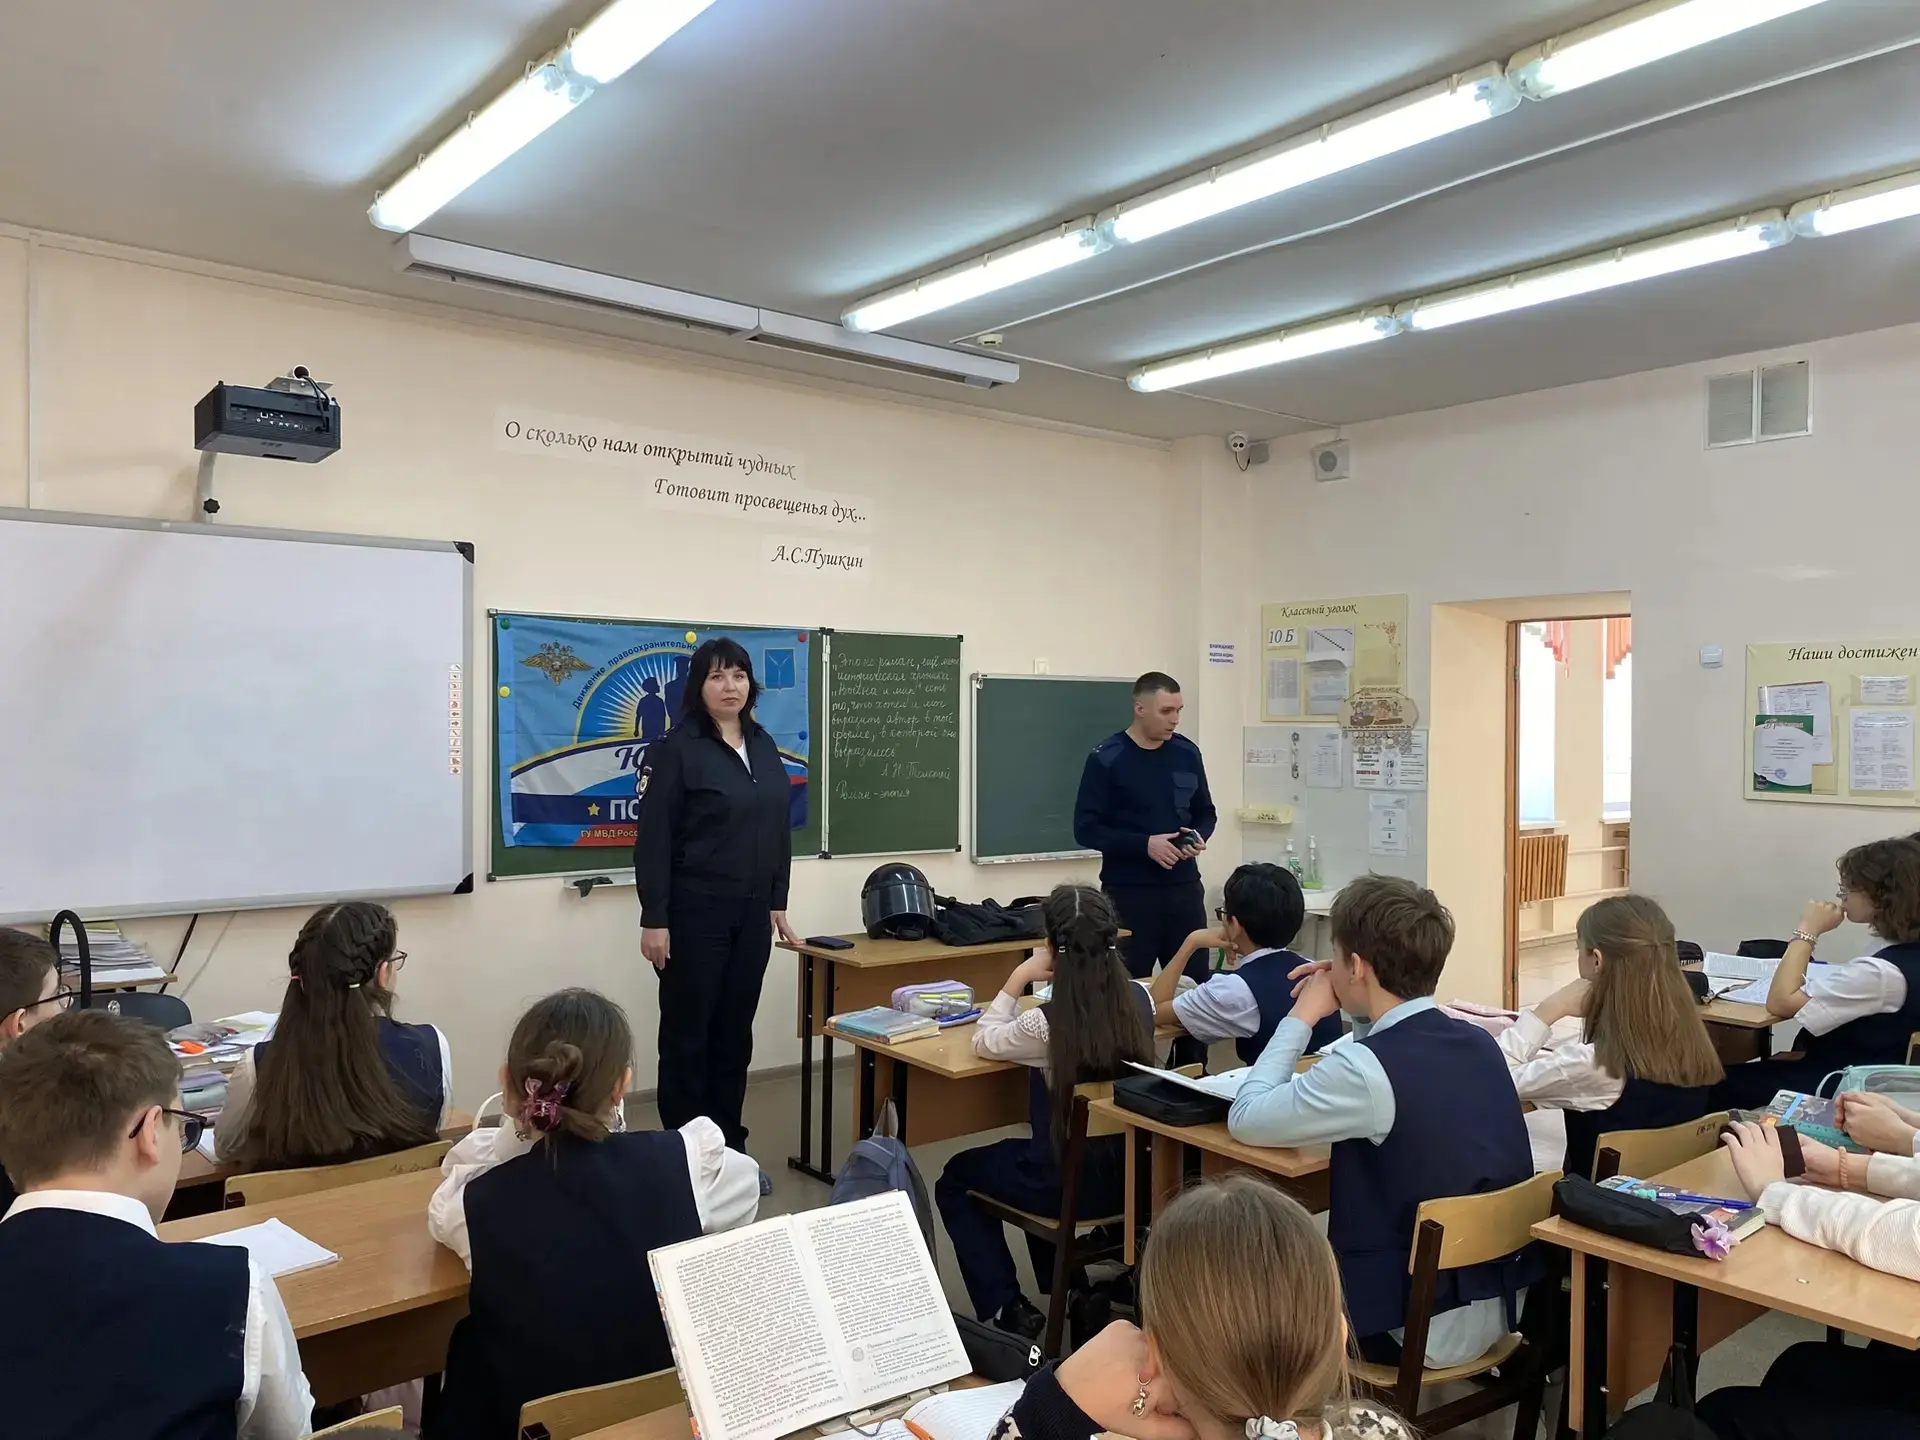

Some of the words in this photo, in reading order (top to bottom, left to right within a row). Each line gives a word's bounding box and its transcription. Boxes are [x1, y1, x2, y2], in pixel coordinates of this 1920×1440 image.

[505, 421, 521, 438] О
[525, 426, 597, 453] сколько
[602, 436, 638, 455] нам
[643, 443, 734, 466] открытий
[738, 454, 797, 480] чудных
[654, 478, 730, 503] Готовит
[735, 491, 828, 516] просвещенья
[831, 500, 866, 523] дух...
[1281, 605, 1325, 618] Классный
[1326, 604, 1358, 617] уголок
[1268, 629, 1283, 643] 10
[1285, 628, 1295, 643] Б
[1788, 647, 1833, 661] Наши
[572, 666, 606, 709] Движение
[594, 829, 616, 838] МВД
